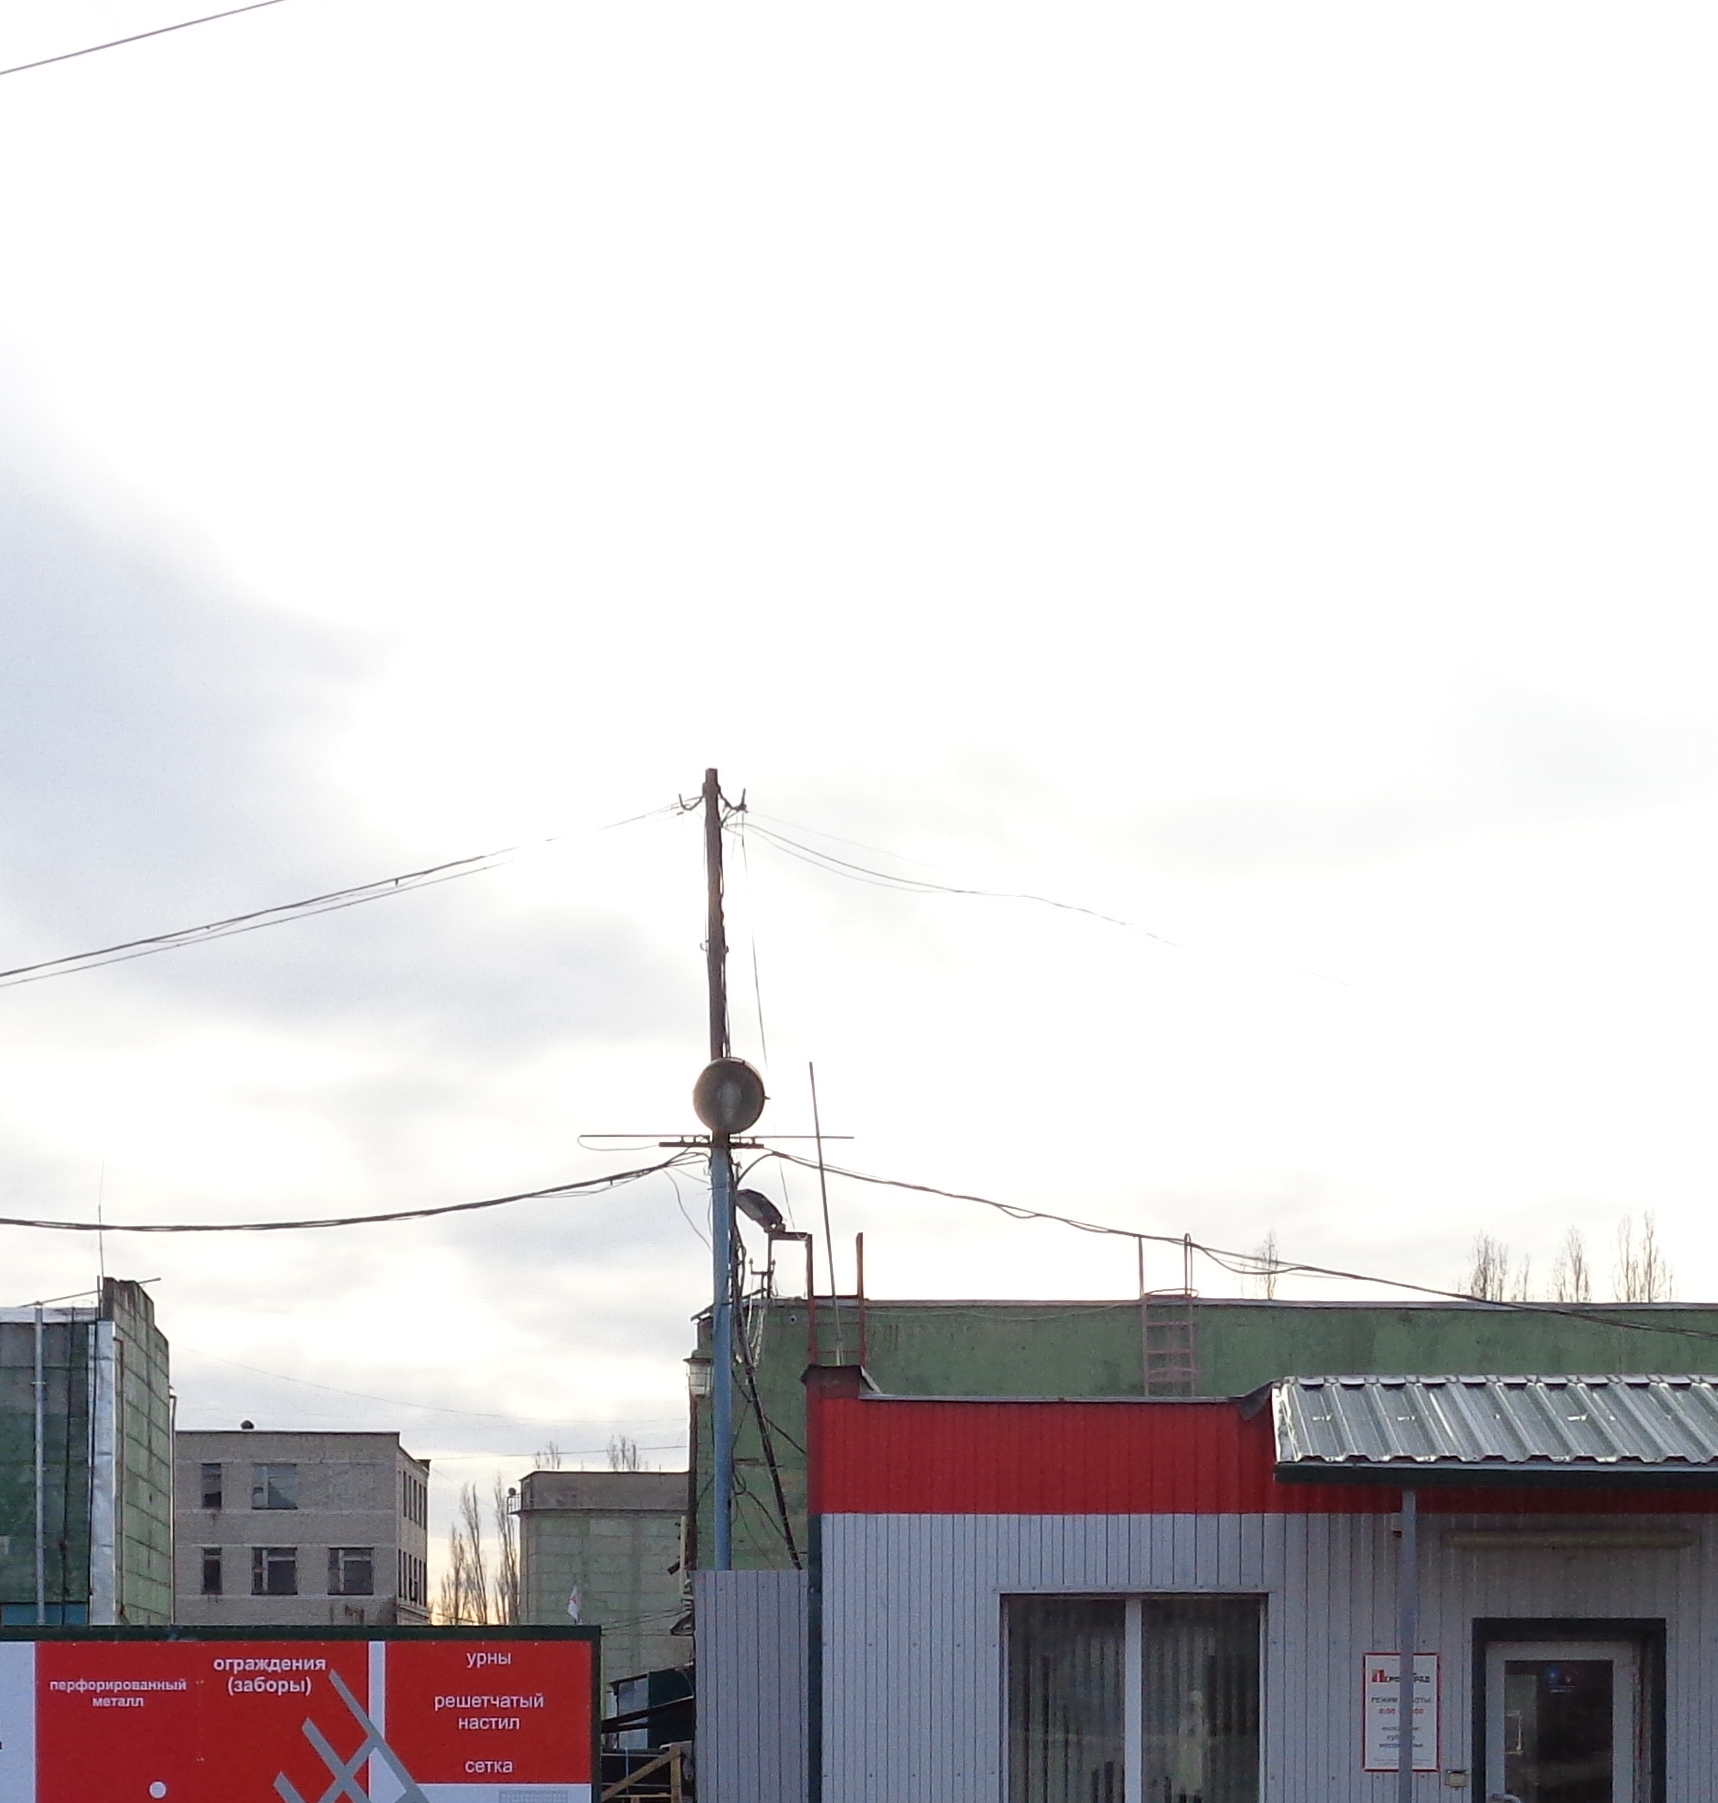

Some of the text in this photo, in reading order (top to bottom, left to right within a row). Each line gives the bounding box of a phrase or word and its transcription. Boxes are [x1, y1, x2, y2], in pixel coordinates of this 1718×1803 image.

[213, 1655, 326, 1673] ограждения
[467, 1652, 512, 1667] урны
[49, 1678, 187, 1693] перфорированный
[228, 1676, 312, 1695] (заборы)
[92, 1697, 144, 1707] металл
[434, 1692, 544, 1711] решетчатый
[458, 1716, 520, 1730] настил
[465, 1760, 513, 1773] сетка
